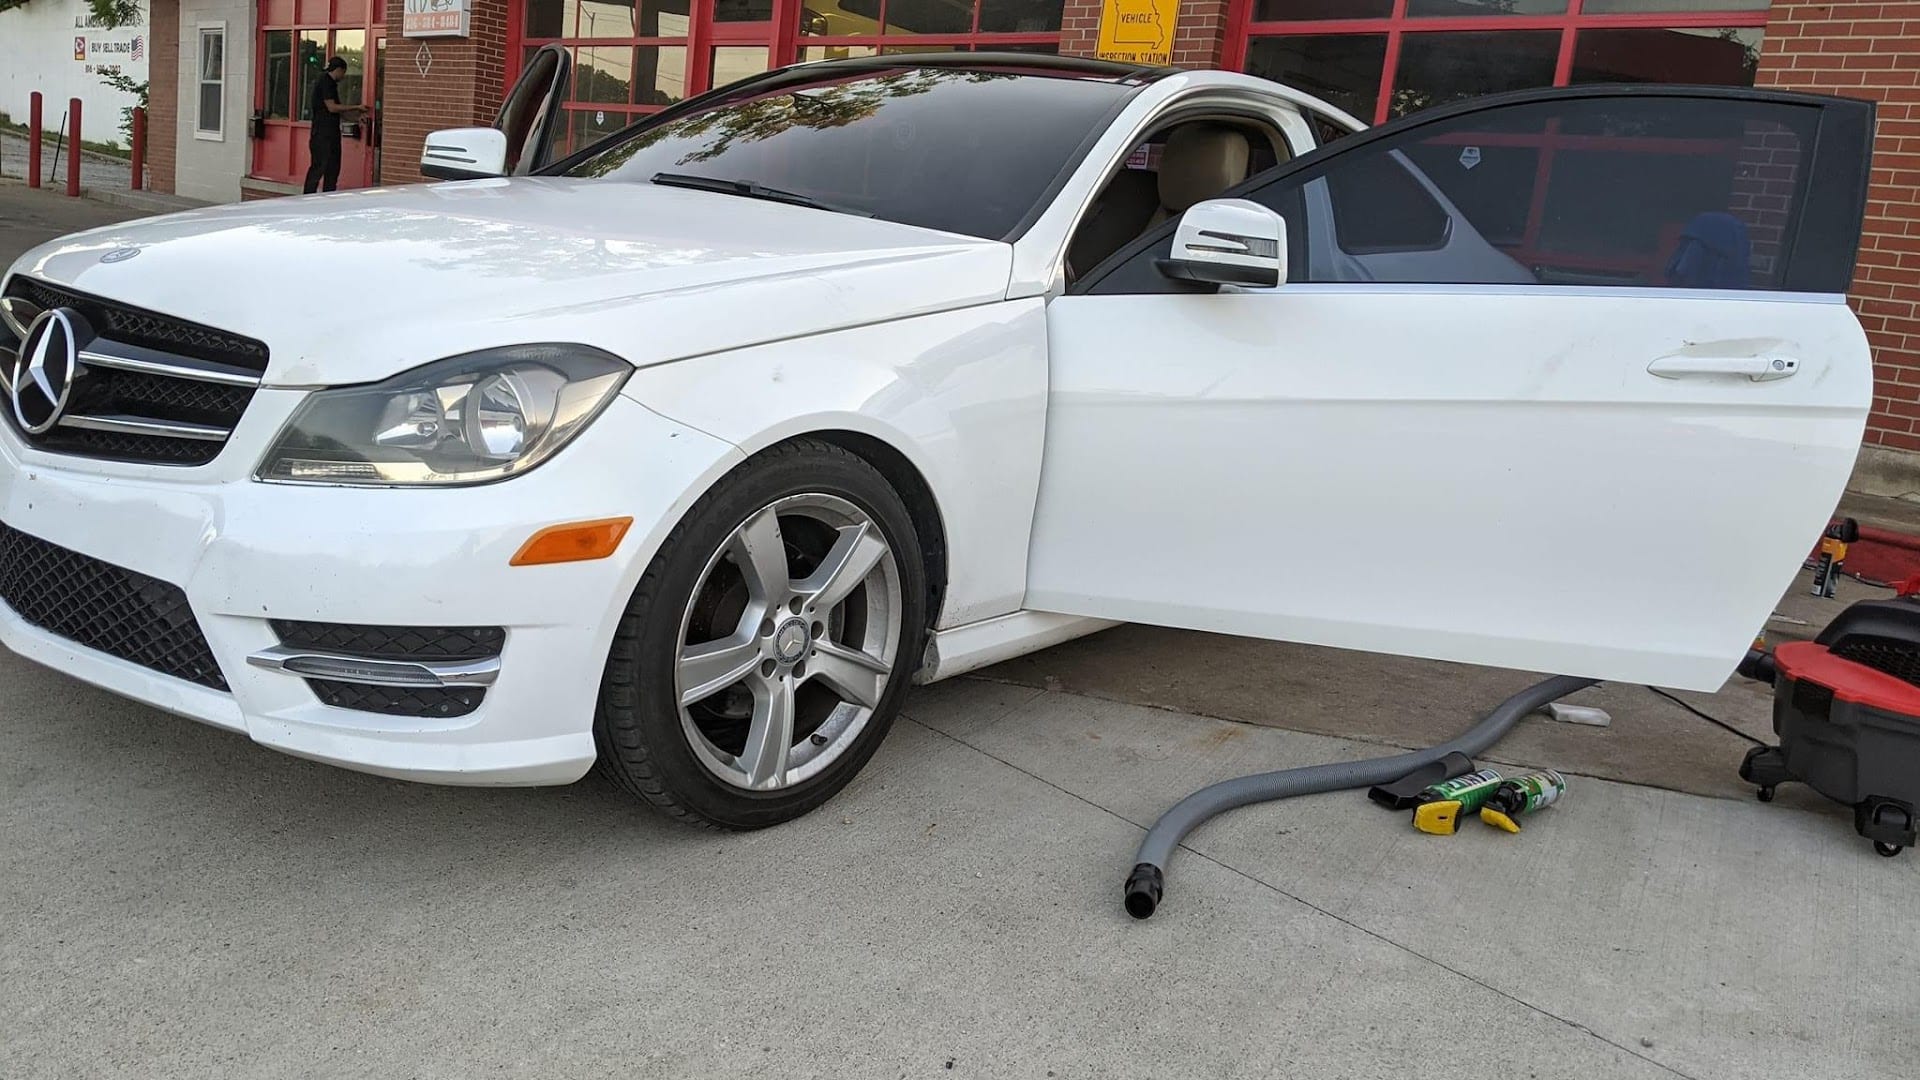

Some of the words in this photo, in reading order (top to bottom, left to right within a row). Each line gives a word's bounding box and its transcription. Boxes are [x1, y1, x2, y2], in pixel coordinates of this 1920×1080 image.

[1121, 13, 1152, 24] VEHICLE
[91, 42, 102, 53] BUY
[103, 42, 114, 53] SELL
[114, 42, 130, 53] TRADE
[1140, 52, 1168, 64] STATION
